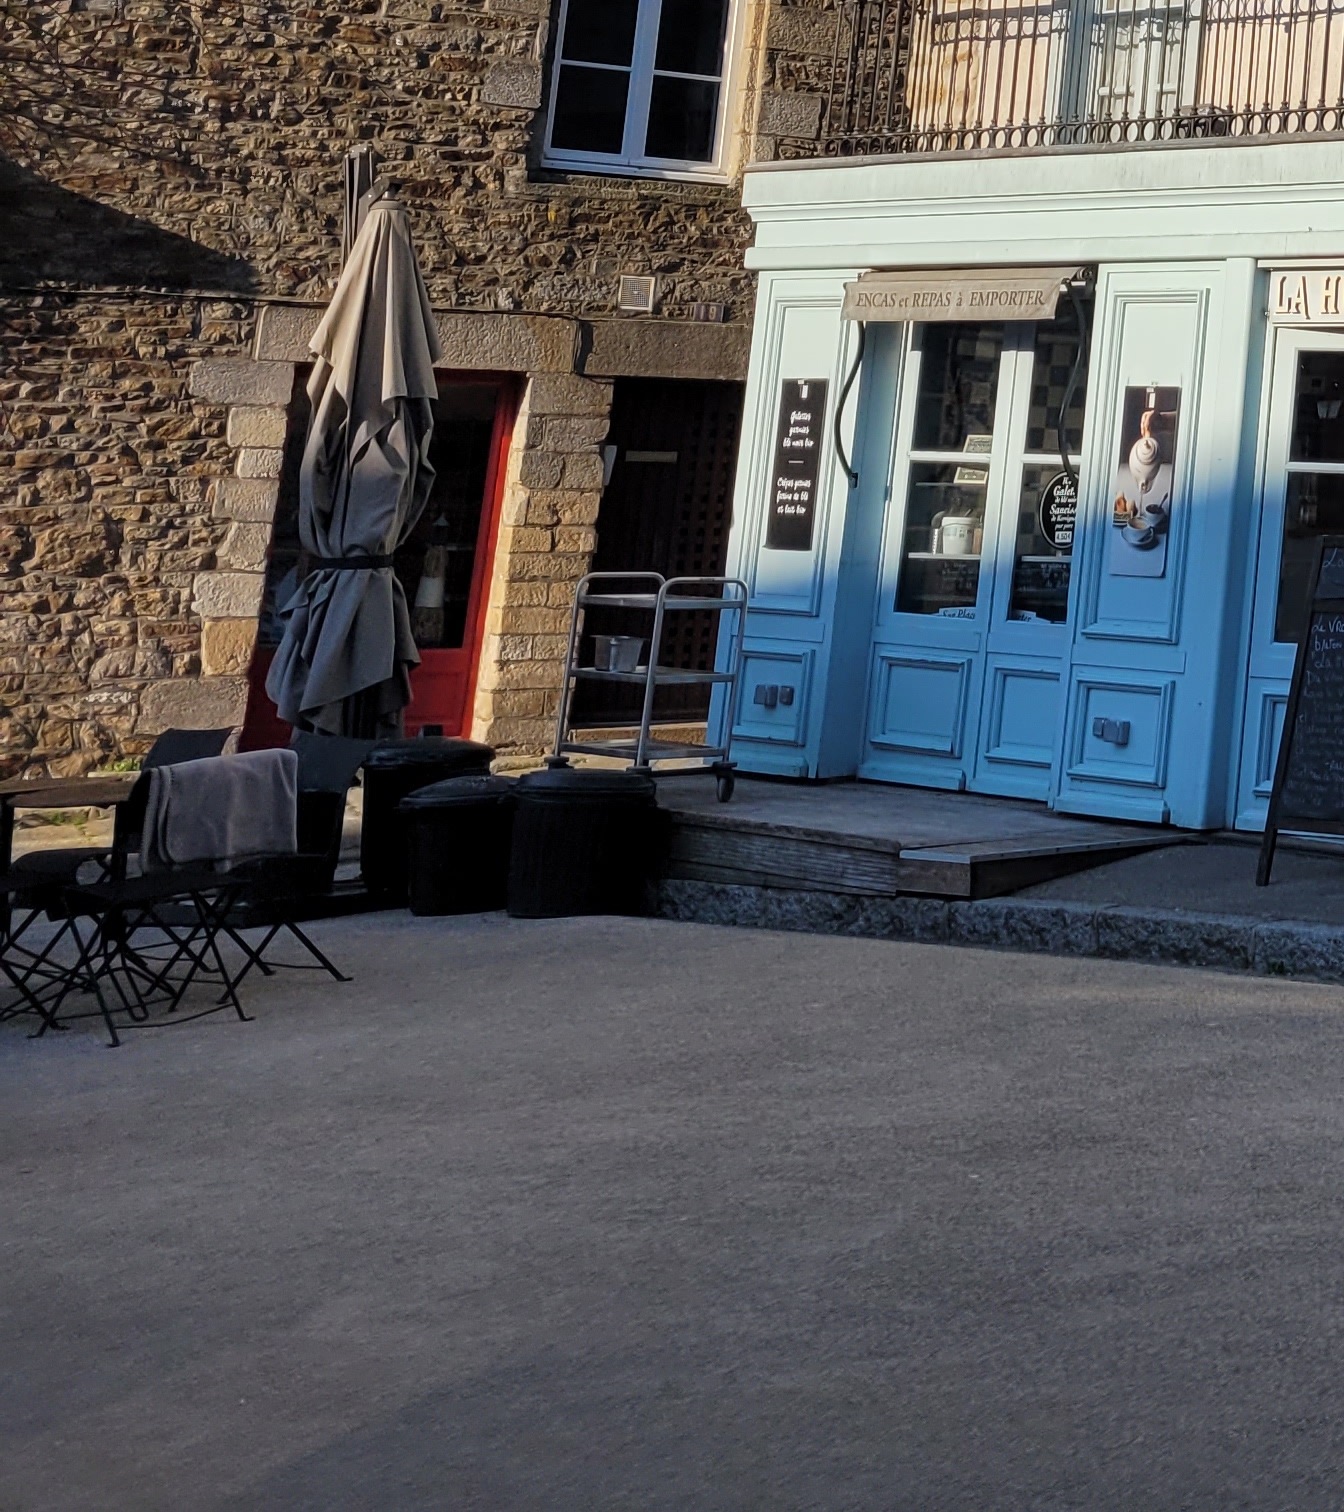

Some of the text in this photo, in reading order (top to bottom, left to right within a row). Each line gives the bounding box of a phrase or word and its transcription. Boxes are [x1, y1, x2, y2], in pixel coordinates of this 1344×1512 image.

[856, 290, 1045, 307] ENCAS et REPAS à EMPORTER
[1274, 275, 1311, 320] LA
